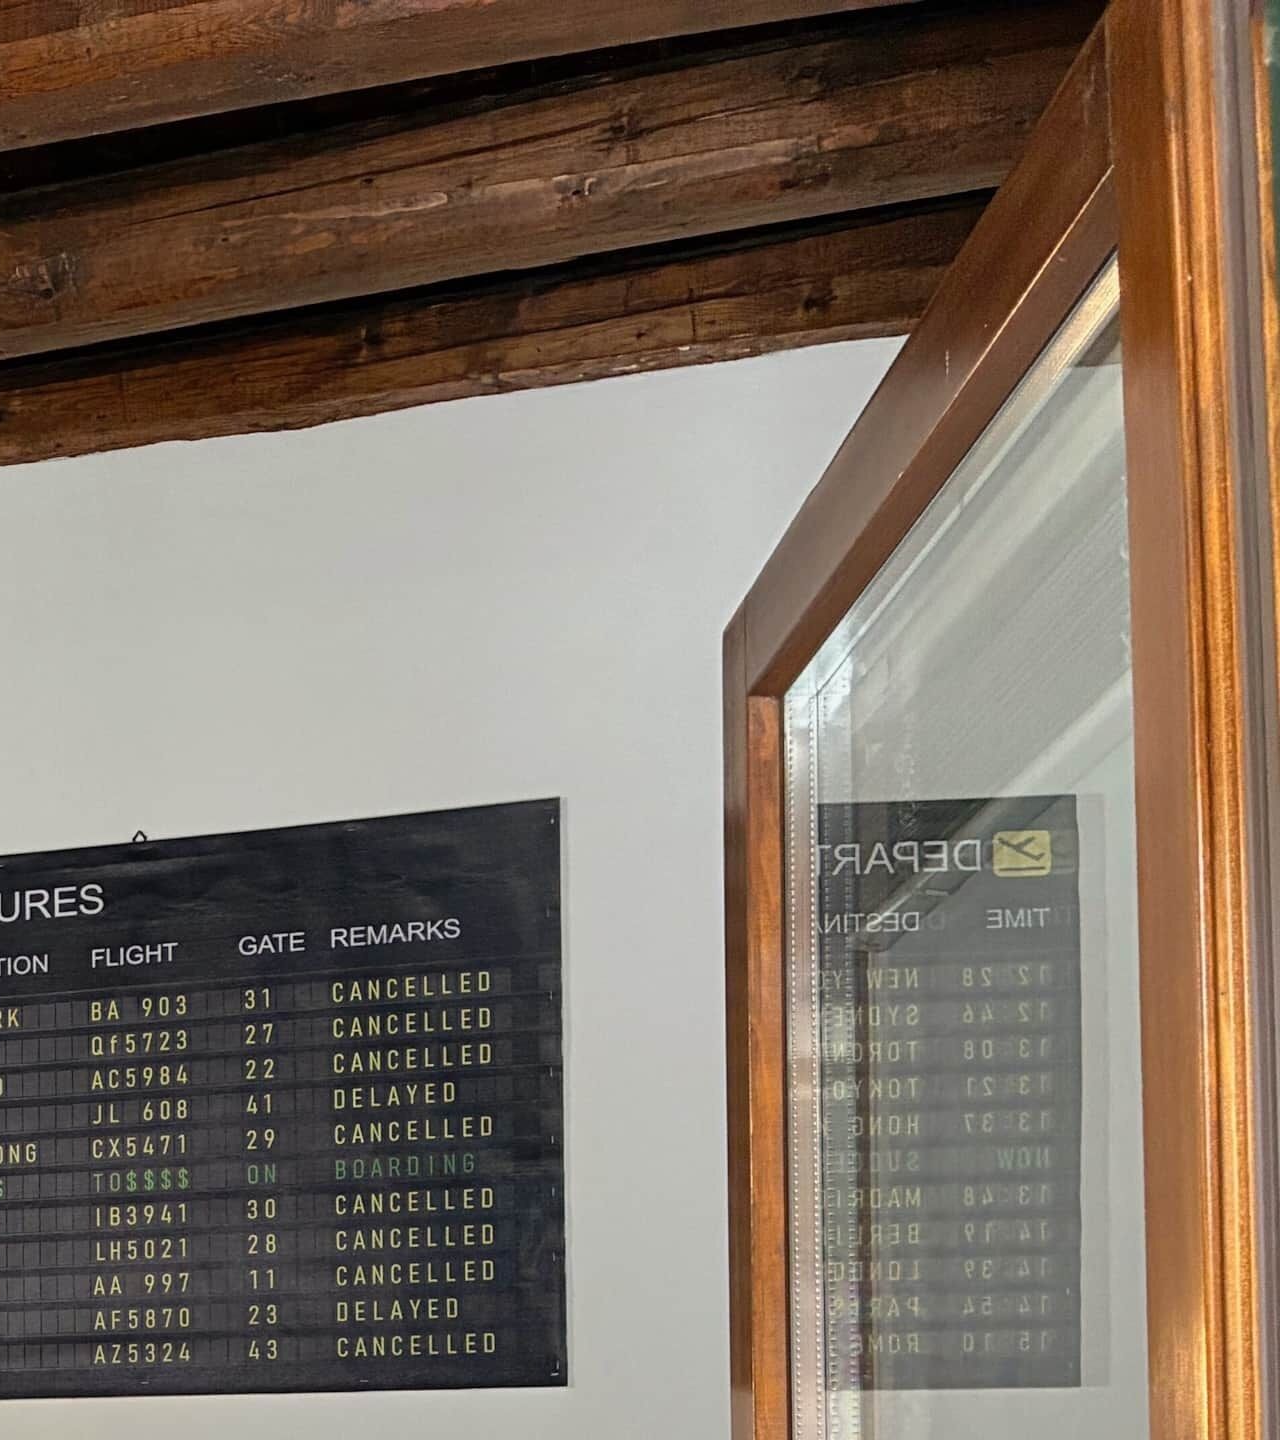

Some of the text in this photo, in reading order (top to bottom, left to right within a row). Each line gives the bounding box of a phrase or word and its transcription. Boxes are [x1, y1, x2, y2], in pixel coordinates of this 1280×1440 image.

[91, 942, 178, 968] FLIGHT
[239, 932, 305, 955] GATE
[331, 918, 461, 948] REMARKS
[91, 1000, 119, 1021] BA
[142, 995, 187, 1016] 903
[245, 988, 270, 1009] 31
[332, 971, 489, 1003] CANCELLED
[91, 1030, 187, 1055] Qf5723
[245, 1023, 273, 1044] 27
[333, 1007, 490, 1038] CANCELLED
[91, 1064, 188, 1090] AC5984
[245, 1059, 274, 1079] 22
[333, 1044, 491, 1073] CANCELLED
[92, 1104, 120, 1125] JL
[143, 1100, 187, 1120] 608
[246, 1094, 272, 1114] 41
[334, 1082, 455, 1109] DELAYED
[93, 1135, 186, 1159] CX5471
[247, 1129, 275, 1149] 29
[335, 1116, 492, 1145] CANCELLED
[94, 1167, 189, 1192] TO$$$$
[248, 1163, 276, 1184] ON
[335, 1153, 474, 1179] BOARDING
[96, 1203, 186, 1227] IB3941
[247, 1198, 276, 1219] 30
[336, 1188, 493, 1215] CANCELLED
[96, 1238, 186, 1261] LH5021
[248, 1234, 276, 1254] 28
[336, 1224, 494, 1250] CANCELLED
[93, 1275, 122, 1296] AA
[144, 1272, 189, 1293] 997
[250, 1269, 274, 1289] 11
[337, 1260, 494, 1286] CANCELLED
[94, 1307, 189, 1330] AF5870
[249, 1304, 277, 1325] 23
[337, 1298, 457, 1322] DELAYED
[94, 1342, 190, 1364] AZ5324
[249, 1339, 277, 1360] 43
[337, 1333, 495, 1357] CANCELLED
